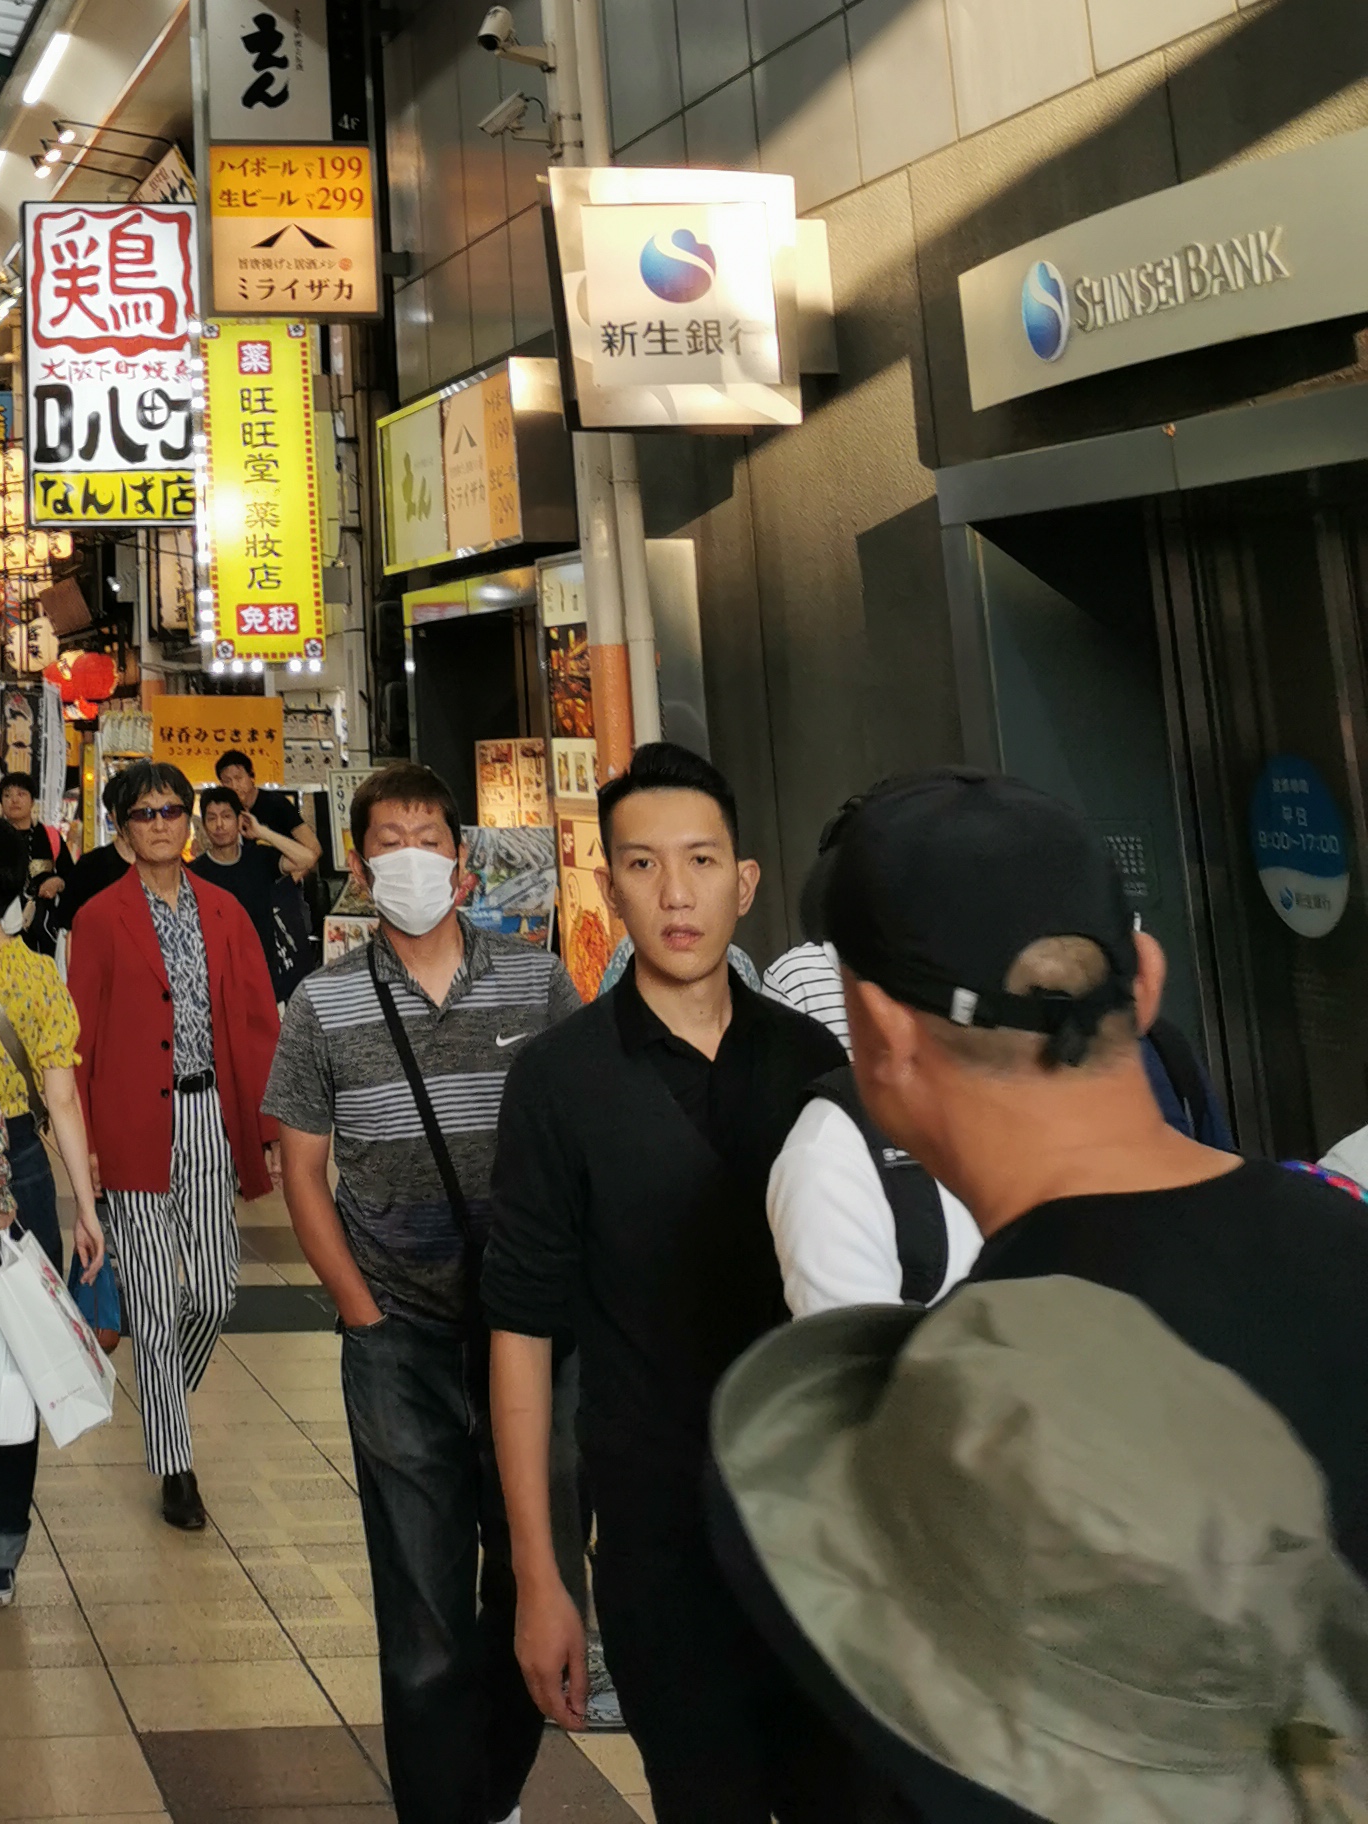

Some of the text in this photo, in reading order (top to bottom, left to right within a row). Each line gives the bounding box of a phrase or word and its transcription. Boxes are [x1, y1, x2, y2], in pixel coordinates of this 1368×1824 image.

[241, 13, 289, 109] えん
[217, 157, 299, 177] ハイボール
[217, 189, 300, 209] 生ビール
[237, 277, 354, 302] ミライザカ
[1074, 225, 1290, 332] SHINSEI BANK
[600, 318, 770, 357] 新生銀行
[240, 343, 271, 372] 薬
[239, 387, 280, 483] 旺旺堂
[39, 475, 196, 516] なんば店
[240, 605, 296, 633] 免税
